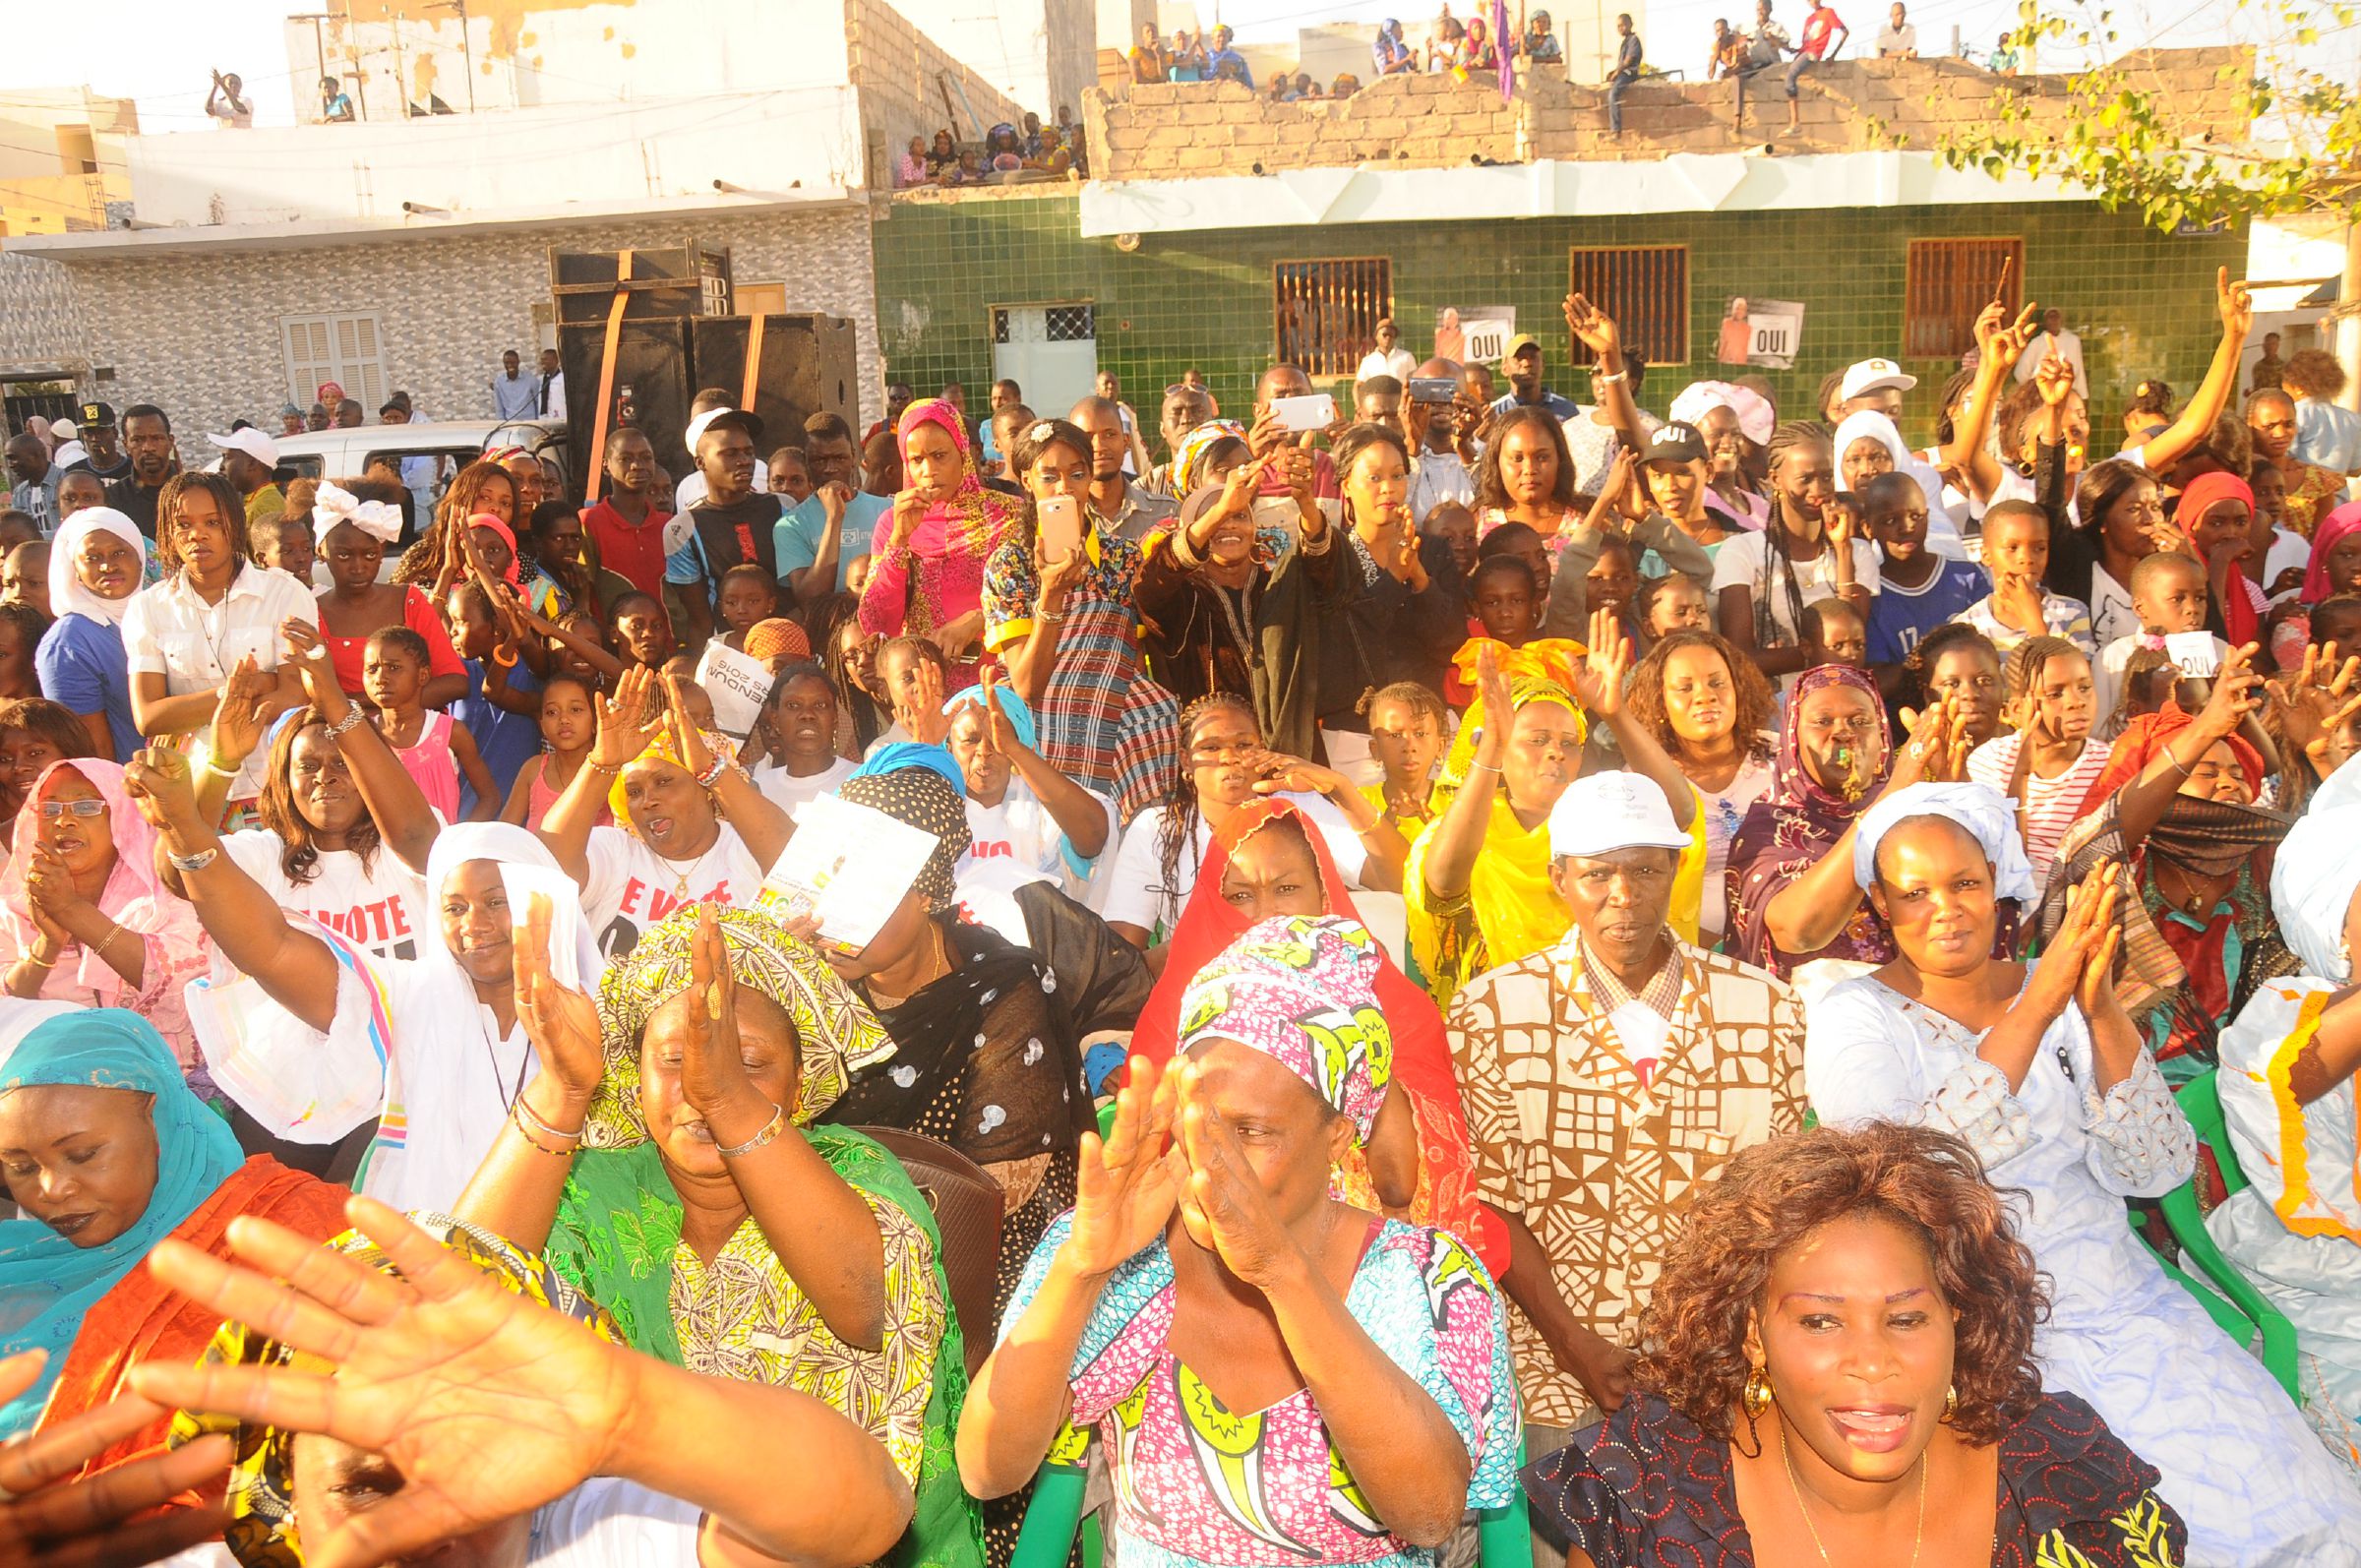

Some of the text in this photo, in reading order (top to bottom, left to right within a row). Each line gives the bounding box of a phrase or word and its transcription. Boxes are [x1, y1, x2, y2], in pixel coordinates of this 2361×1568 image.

[1473, 334, 1501, 359] OUI
[1758, 330, 1786, 353] OUI
[1652, 425, 1686, 447] OUI
[717, 659, 750, 683] 2016
[2182, 656, 2211, 676] OUI
